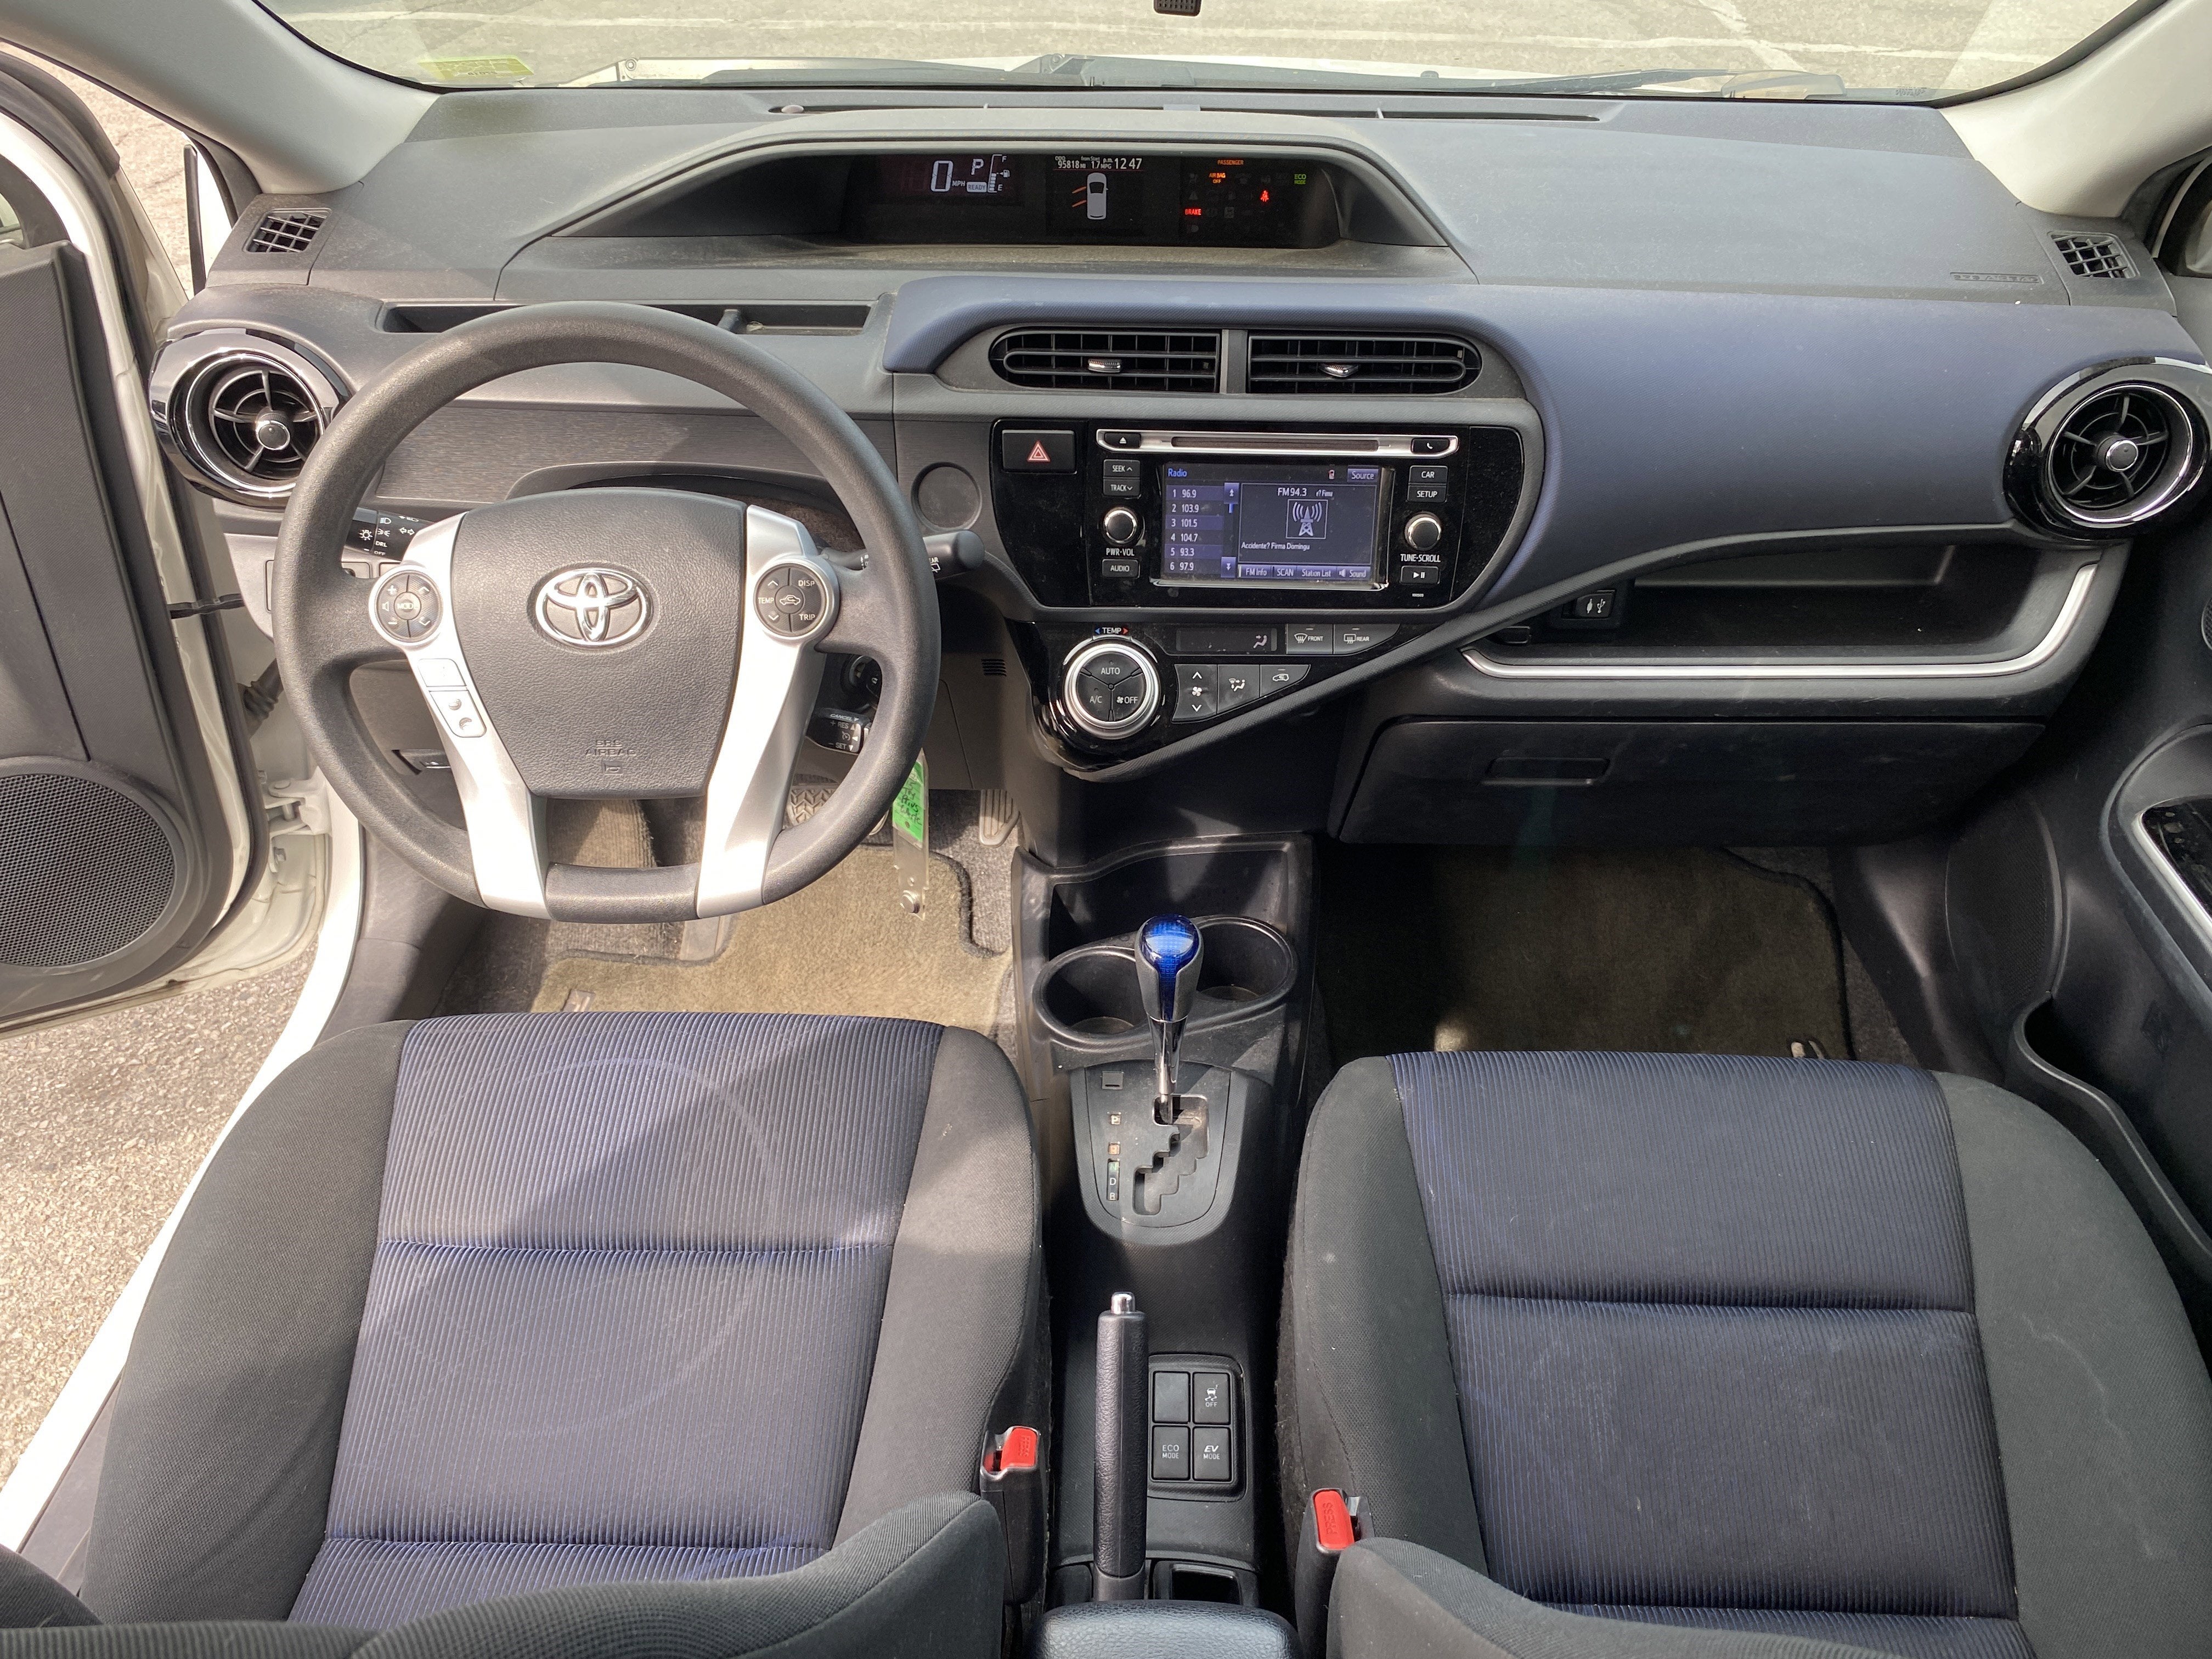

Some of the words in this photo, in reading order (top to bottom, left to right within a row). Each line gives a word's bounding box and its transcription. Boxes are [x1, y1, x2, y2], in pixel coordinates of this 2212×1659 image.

[971, 159, 984, 175] P
[1058, 160, 1079, 168] 95818
[930, 160, 953, 192] 0
[1167, 468, 1187, 477] Radio
[1351, 471, 1374, 479] Source
[1173, 489, 1176, 498] 1
[1182, 489, 1197, 498] 96.9
[1172, 504, 1176, 512] 2
[1182, 504, 1199, 512] 103.9
[1181, 519, 1198, 527] 101.5
[1171, 533, 1176, 541] 4
[1181, 534, 1198, 542] 104.7
[1180, 548, 1194, 556] 93.3
[1180, 562, 1194, 571] 97.9
[1350, 569, 1366, 578] Sound
[1089, 695, 1102, 704] A/C
[837, 721, 849, 729] RES
[1322, 1502, 1338, 1534] PRESS
